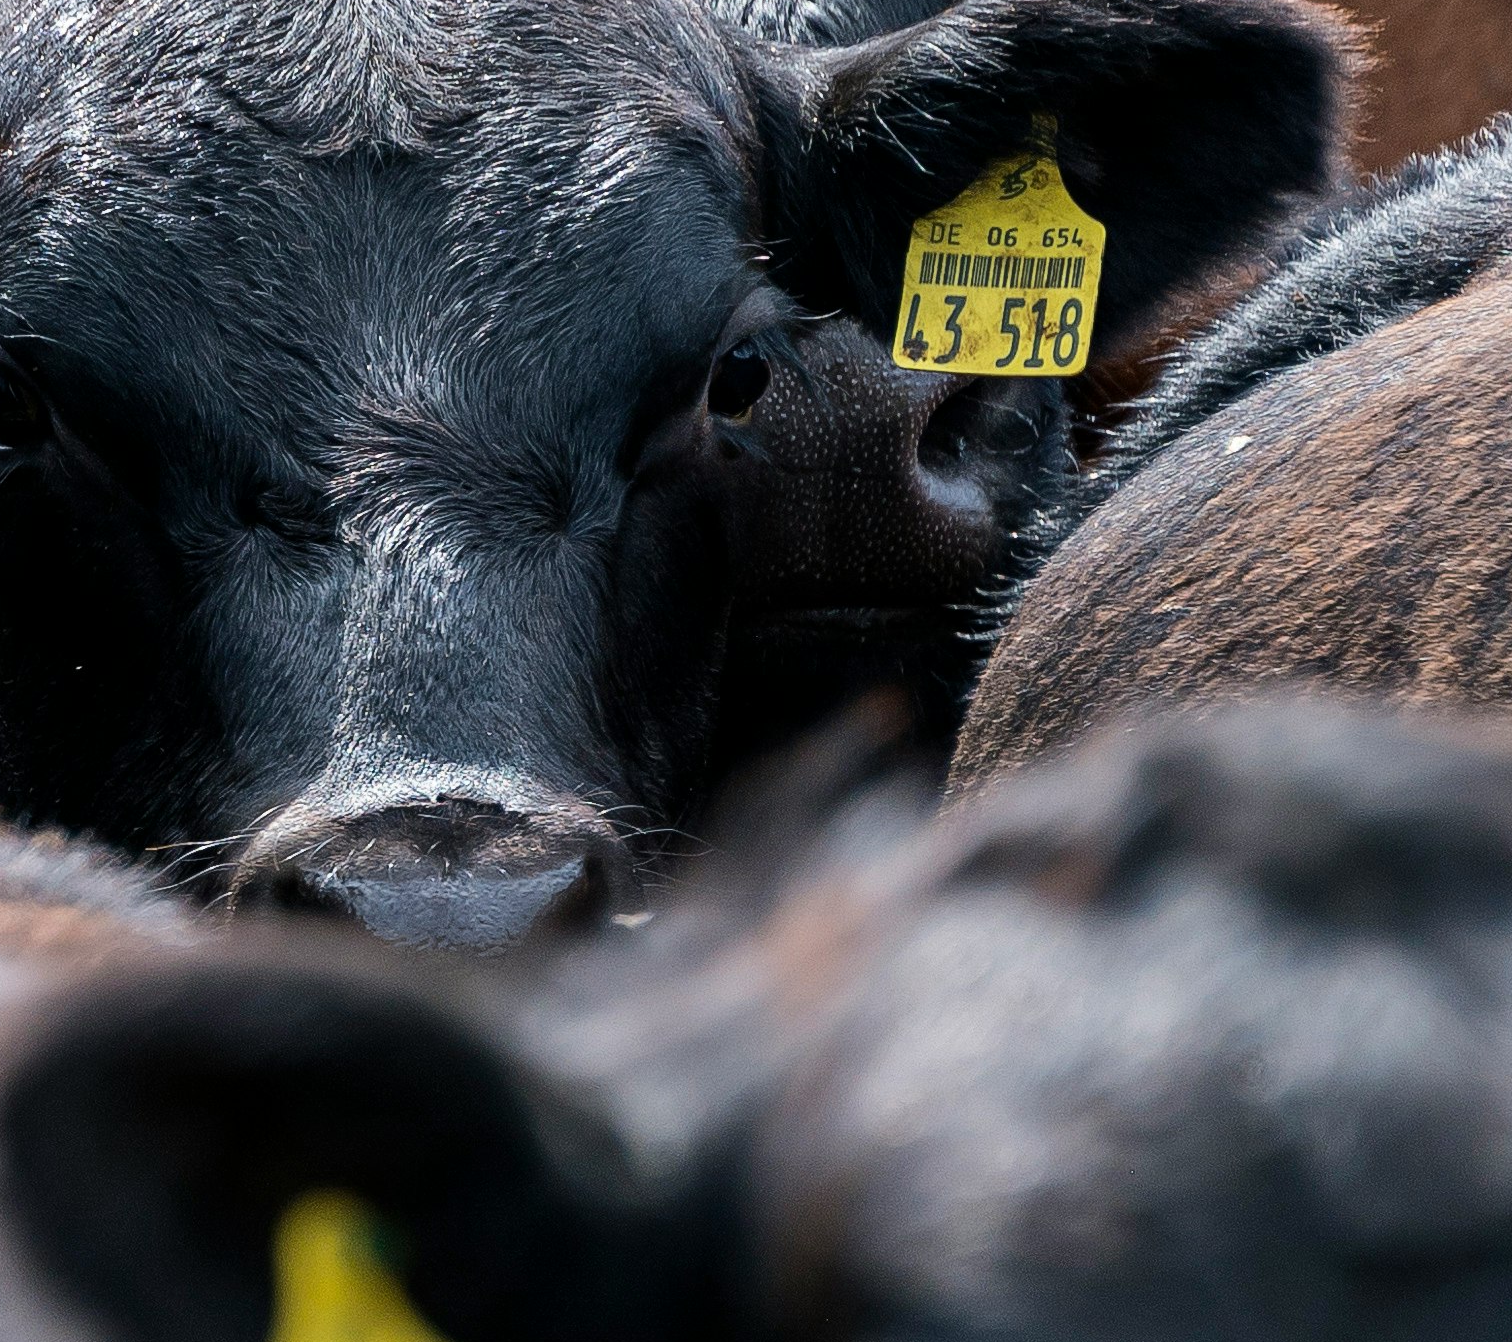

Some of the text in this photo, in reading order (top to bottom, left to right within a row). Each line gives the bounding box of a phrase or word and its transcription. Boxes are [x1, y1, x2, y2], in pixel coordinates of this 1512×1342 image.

[930, 222, 1083, 248] DE 06 654
[995, 297, 1083, 369] 518
